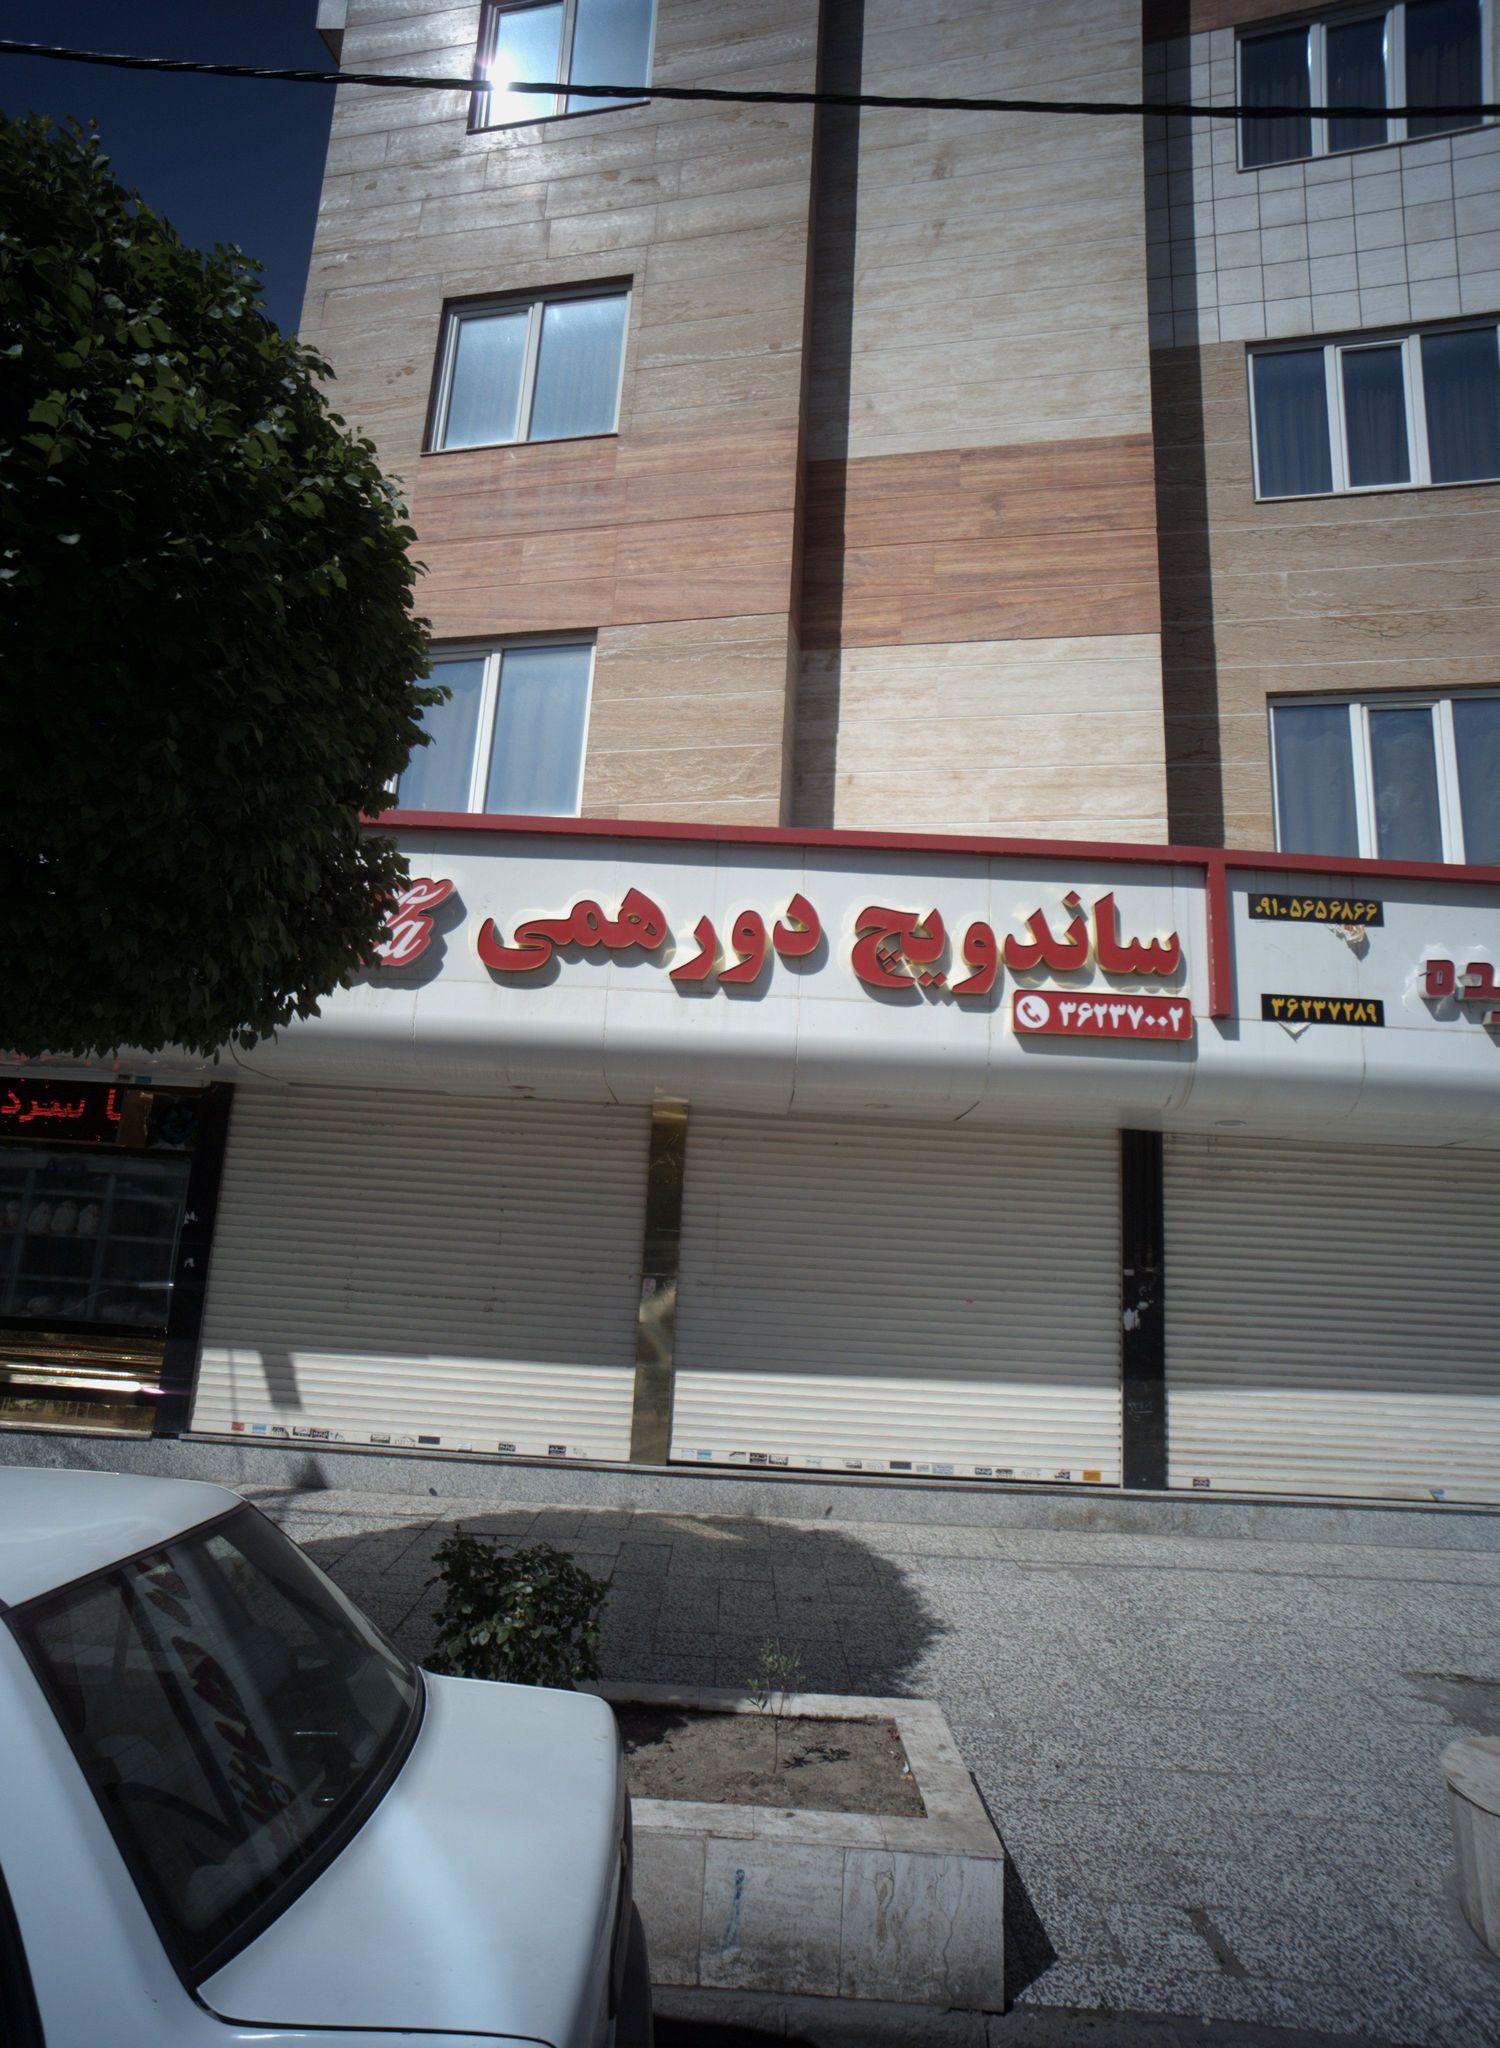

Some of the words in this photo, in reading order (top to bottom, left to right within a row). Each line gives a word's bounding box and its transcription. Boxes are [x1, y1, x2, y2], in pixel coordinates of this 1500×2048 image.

[1255, 896, 1378, 921] ۰۹۱۰۵۶۵۶۸۶۶
[851, 890, 1181, 995] ساندویچ
[1058, 1001, 1184, 1032] ۳۶۲۳۷۰۰۲
[1271, 998, 1377, 1023] ۳۶۲۳۷۲۸۹
